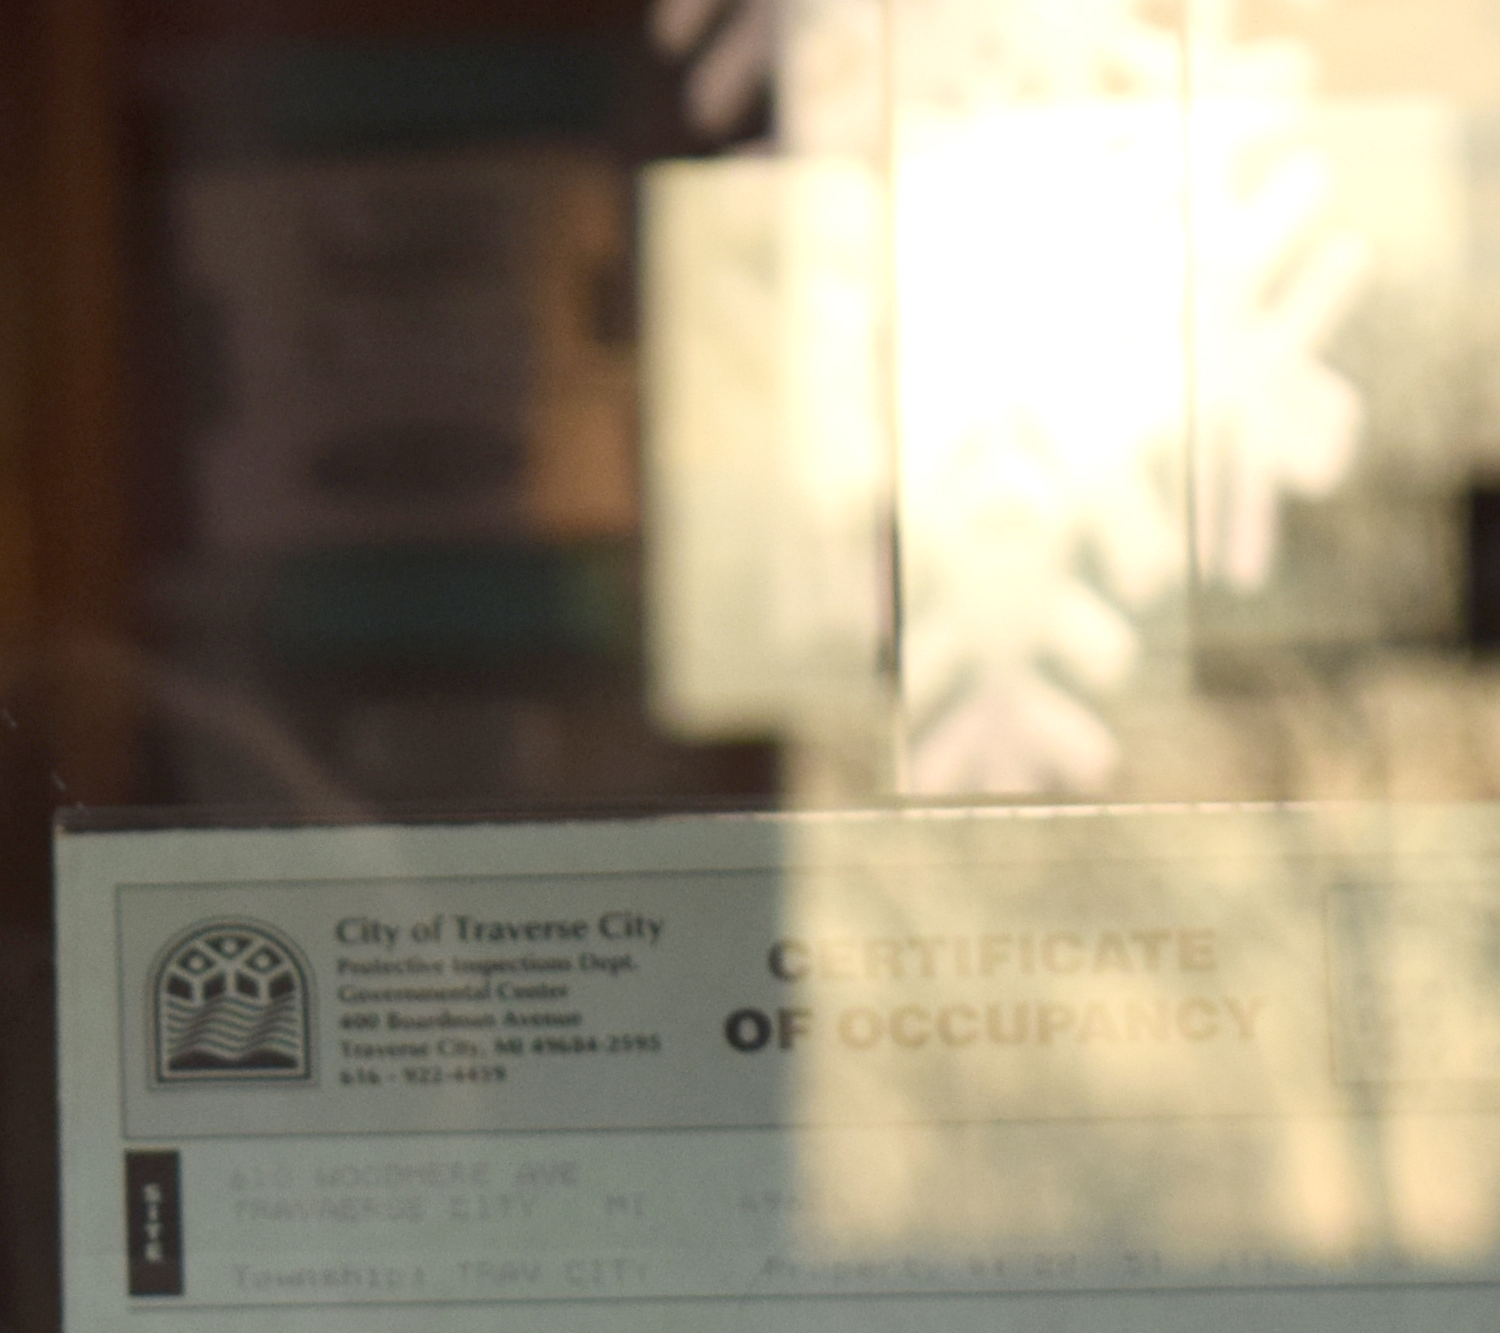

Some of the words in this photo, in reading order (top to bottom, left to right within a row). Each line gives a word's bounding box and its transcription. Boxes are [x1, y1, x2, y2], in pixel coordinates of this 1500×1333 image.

[335, 916, 398, 950] City
[410, 914, 443, 943] of
[455, 914, 588, 943] Traverse
[598, 911, 663, 943] City
[767, 929, 1219, 983] CERTIFICATE
[723, 1006, 814, 1053] OF
[836, 996, 1267, 1052] OCCUPANCY
